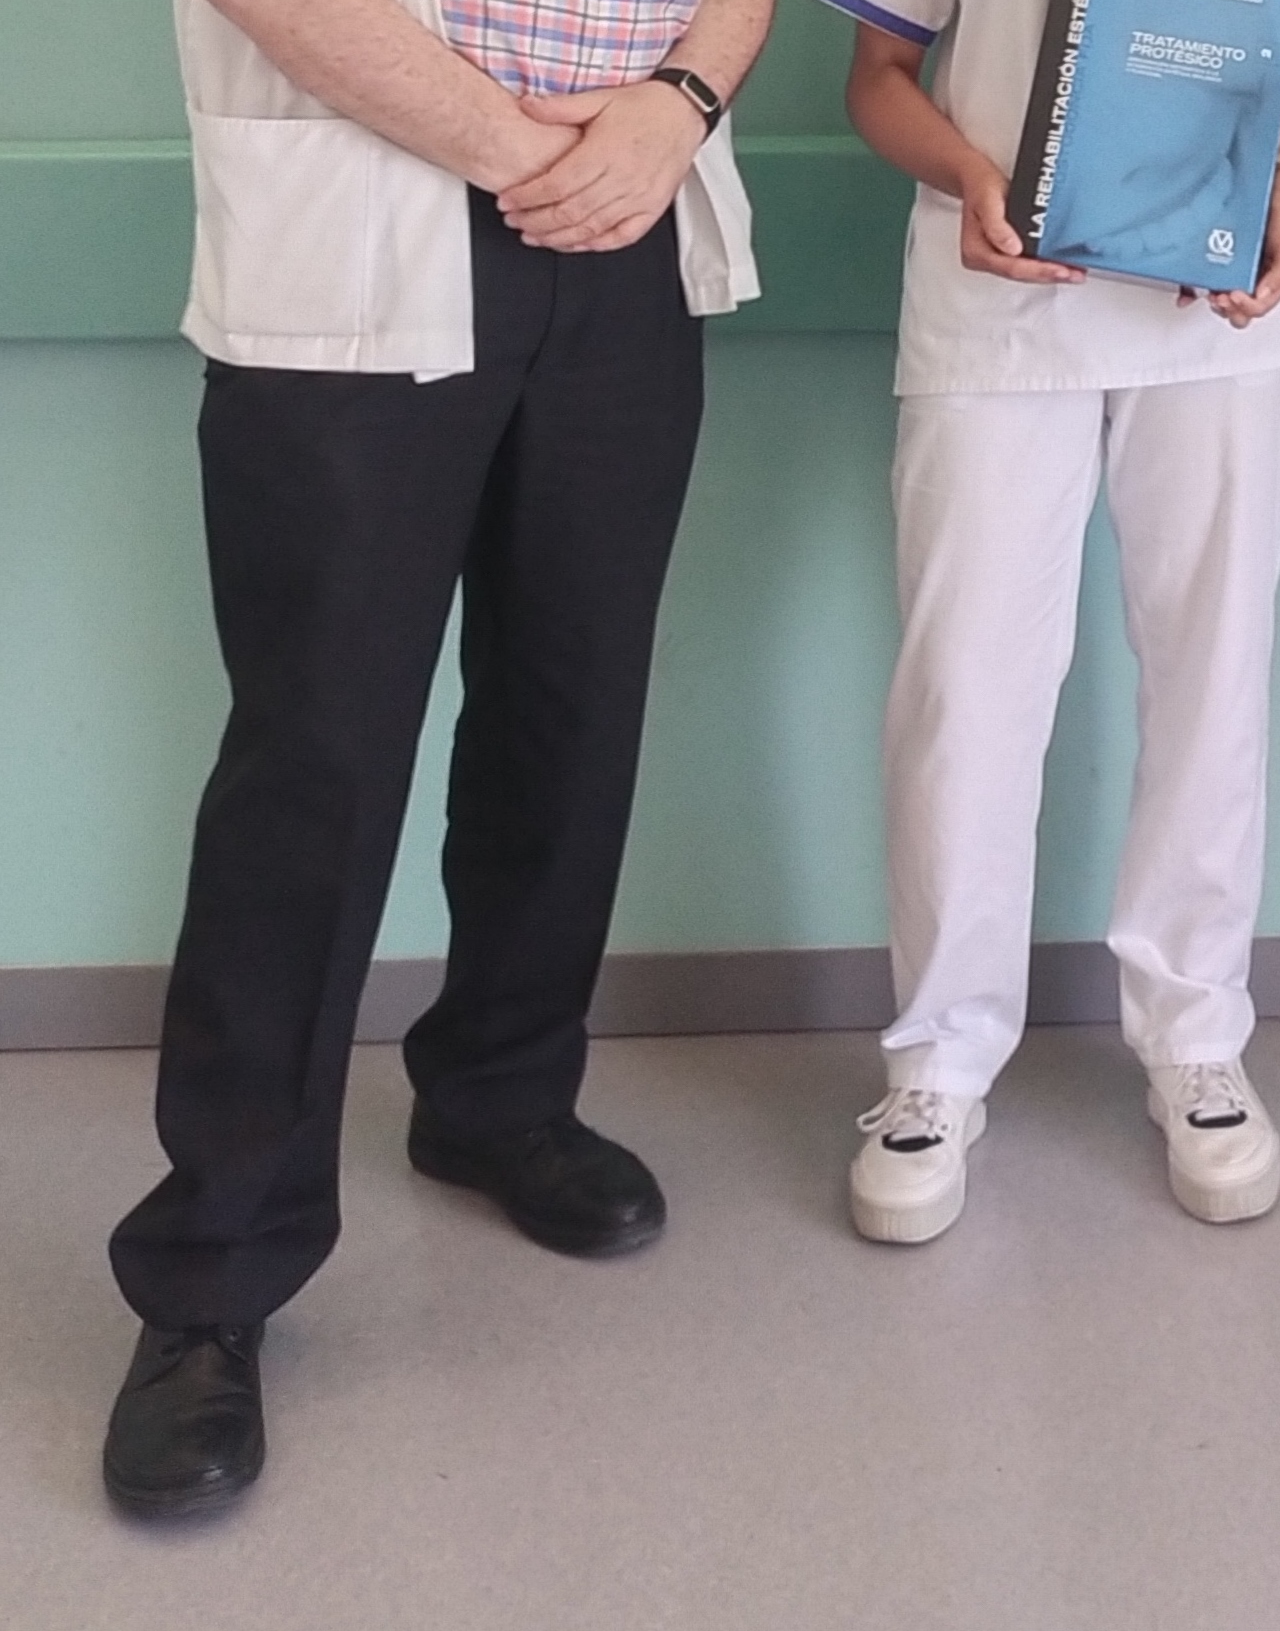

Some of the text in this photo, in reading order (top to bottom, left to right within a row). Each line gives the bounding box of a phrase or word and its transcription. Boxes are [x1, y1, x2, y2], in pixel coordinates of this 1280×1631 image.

[1128, 42, 1223, 70] PROTÉSICO
[1131, 30, 1246, 62] TRATAMIENTO
[1034, 48, 1079, 207] REHABILITACIÓN
[1028, 212, 1047, 239] LA
